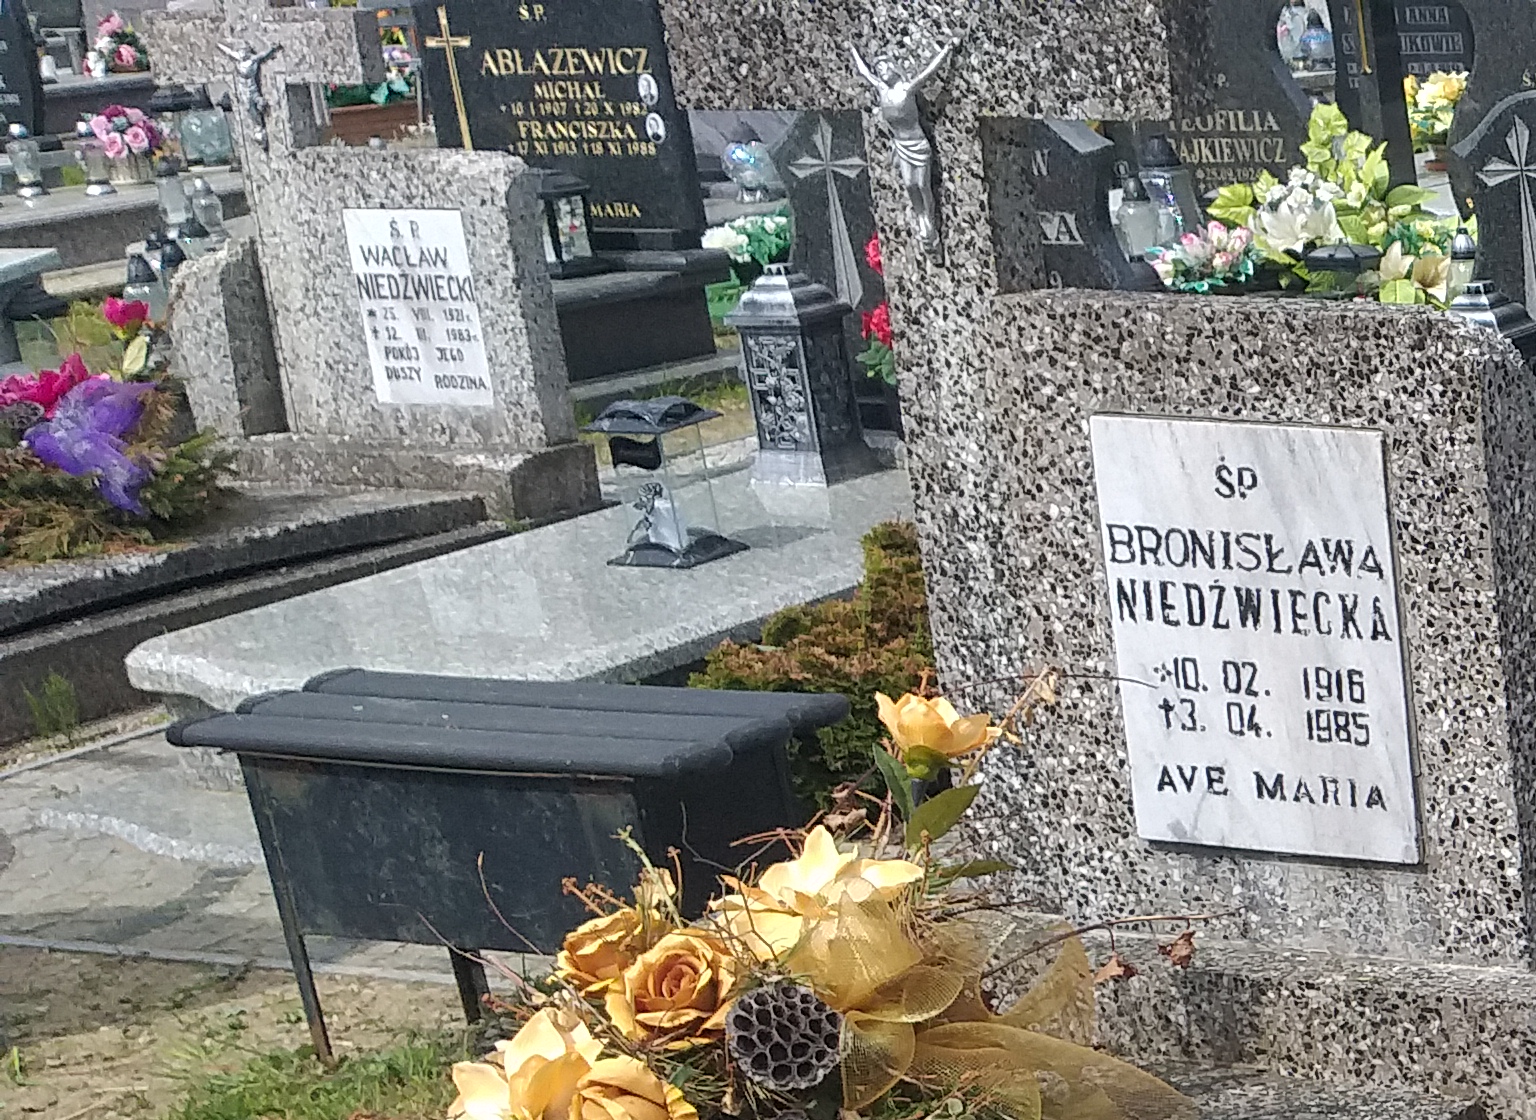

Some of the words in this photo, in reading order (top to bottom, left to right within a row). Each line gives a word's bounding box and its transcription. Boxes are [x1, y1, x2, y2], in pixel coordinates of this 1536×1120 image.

[517, 121, 638, 140] FRANCISZKA
[590, 203, 641, 218] MARIA
[359, 245, 448, 269] WACŁAW
[385, 366, 422, 383] DUSZY
[1106, 523, 1385, 580] BRONISŁAWA
[1303, 666, 1366, 704] 1916
[1305, 708, 1372, 747] 1985
[1157, 764, 1228, 796] AVE
[1253, 770, 1388, 812] MARIA
